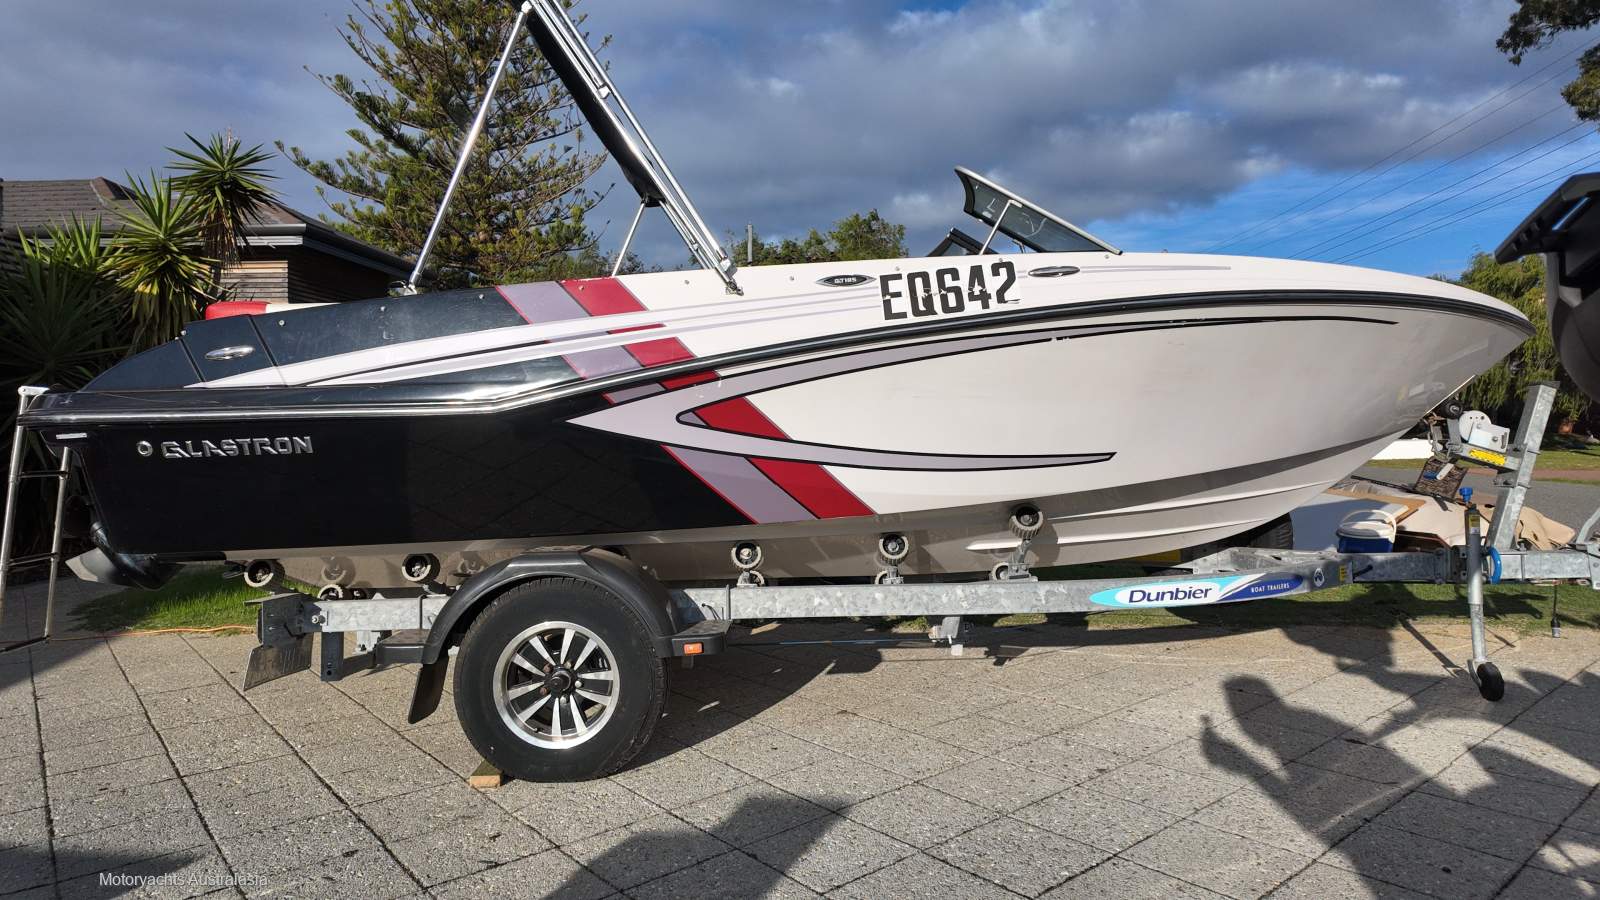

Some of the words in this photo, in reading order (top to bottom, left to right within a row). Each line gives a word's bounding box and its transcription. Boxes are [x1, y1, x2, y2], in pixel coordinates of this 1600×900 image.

[880, 261, 1020, 320] EQ642
[161, 436, 313, 458] GLASTRON
[1128, 586, 1213, 604] Dunbier
[1250, 585, 1265, 593] BOAT
[1267, 582, 1290, 591] TRAILERS
